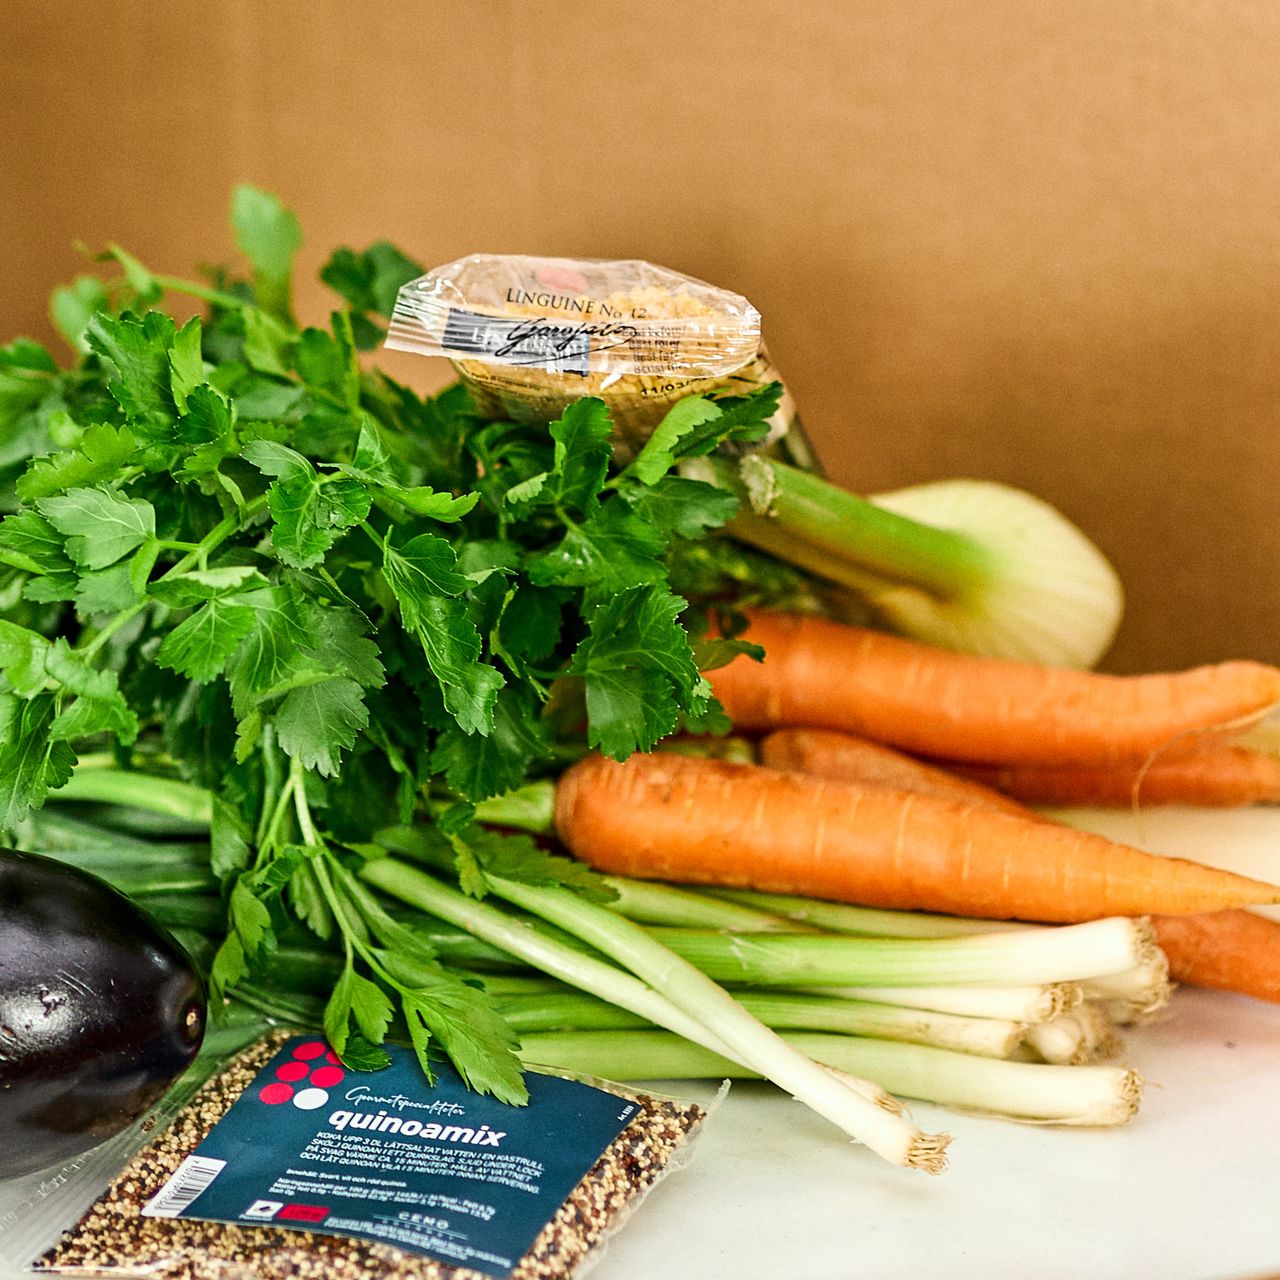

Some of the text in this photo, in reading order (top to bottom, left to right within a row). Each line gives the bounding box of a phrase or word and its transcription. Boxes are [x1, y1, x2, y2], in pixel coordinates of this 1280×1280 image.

[506, 287, 596, 314] LINGUINE
[328, 1110, 507, 1147] quinoamix
[316, 1131, 342, 1141] KOKA
[342, 1135, 364, 1143] UPP
[362, 1137, 371, 1145] 3
[369, 1139, 382, 1147] DL
[441, 1148, 477, 1159] VATTEN
[481, 1153, 497, 1161] EN
[340, 1142, 383, 1154] QUINOAN
[386, 1149, 406, 1157] ETT
[457, 1157, 483, 1166] SJUD
[483, 1161, 516, 1170] UNDER
[516, 1165, 542, 1178] LOCK
[299, 1151, 321, 1161] OCH
[319, 1154, 340, 1163] LÅT
[338, 1157, 381, 1169] QUINOAN
[413, 1166, 456, 1176] MINUTER
[305, 1144, 320, 1153] PÅ
[318, 1147, 346, 1157] SVAG
[490, 1168, 533, 1182] VATTNET
